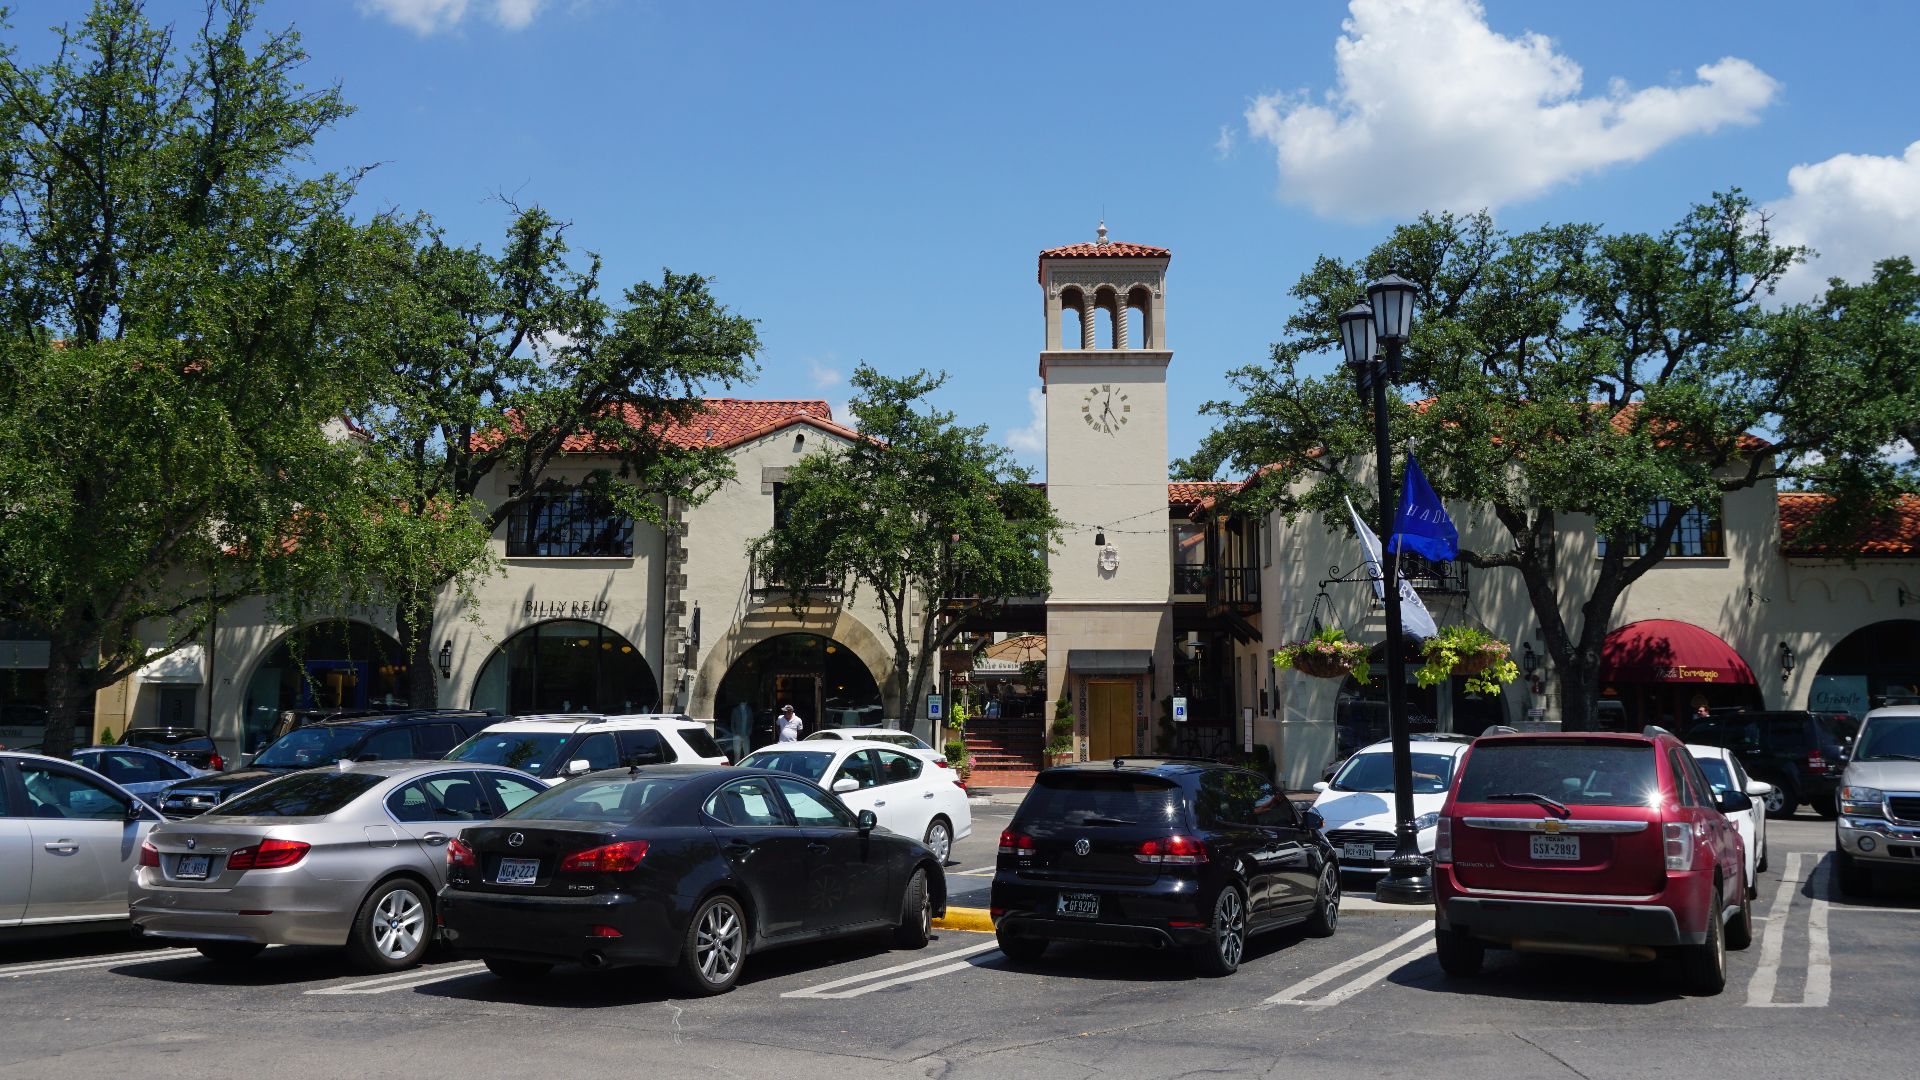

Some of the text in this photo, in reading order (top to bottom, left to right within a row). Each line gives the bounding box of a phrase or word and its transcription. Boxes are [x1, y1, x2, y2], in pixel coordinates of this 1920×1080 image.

[525, 600, 608, 612] BILLY REID
[1678, 665, 1719, 683] Formaggio
[1816, 690, 1862, 706] Christofle
